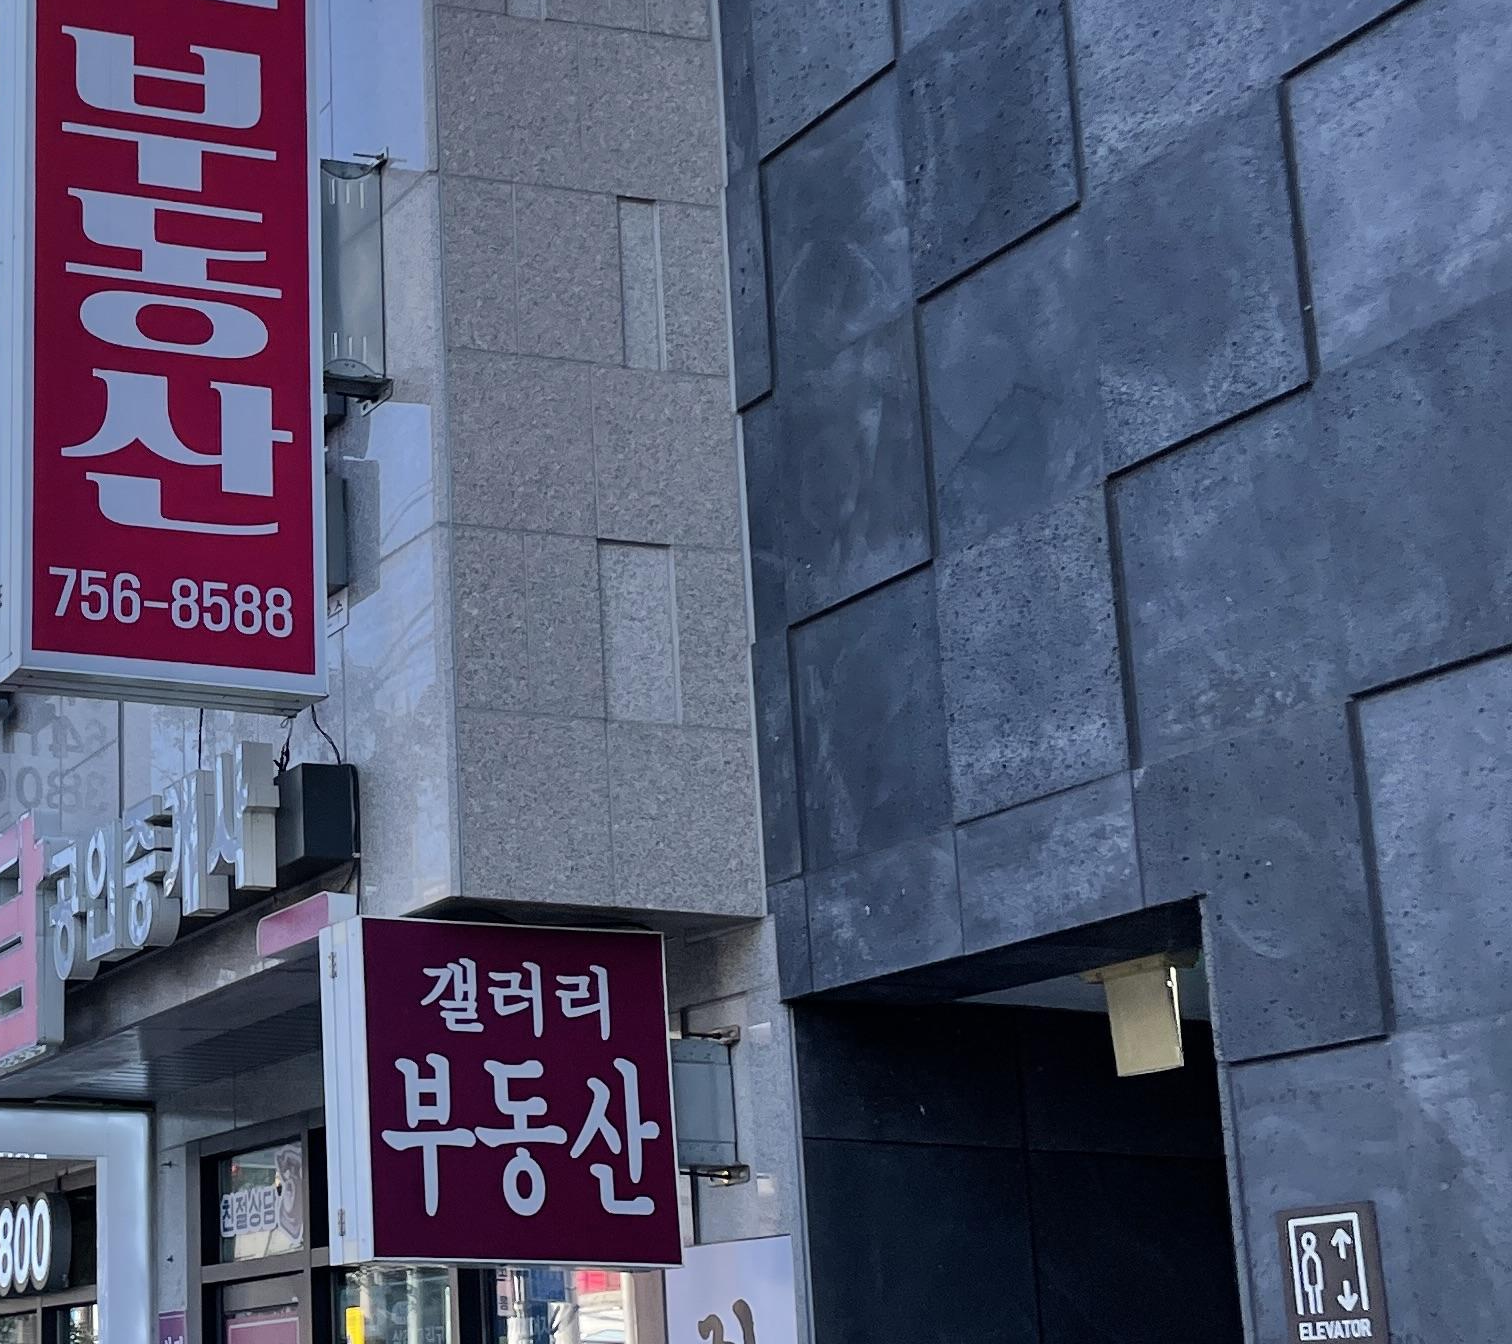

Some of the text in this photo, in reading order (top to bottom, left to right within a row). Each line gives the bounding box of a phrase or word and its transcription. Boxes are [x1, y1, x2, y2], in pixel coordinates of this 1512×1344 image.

[60, 24, 294, 537] 부동산
[48, 565, 294, 639] 756-8588
[48, 742, 278, 980] 공인중개사
[421, 957, 612, 1041] 갤러리
[381, 1053, 660, 1217] 부동산
[1298, 1318, 1373, 1342] ELEVATOR
